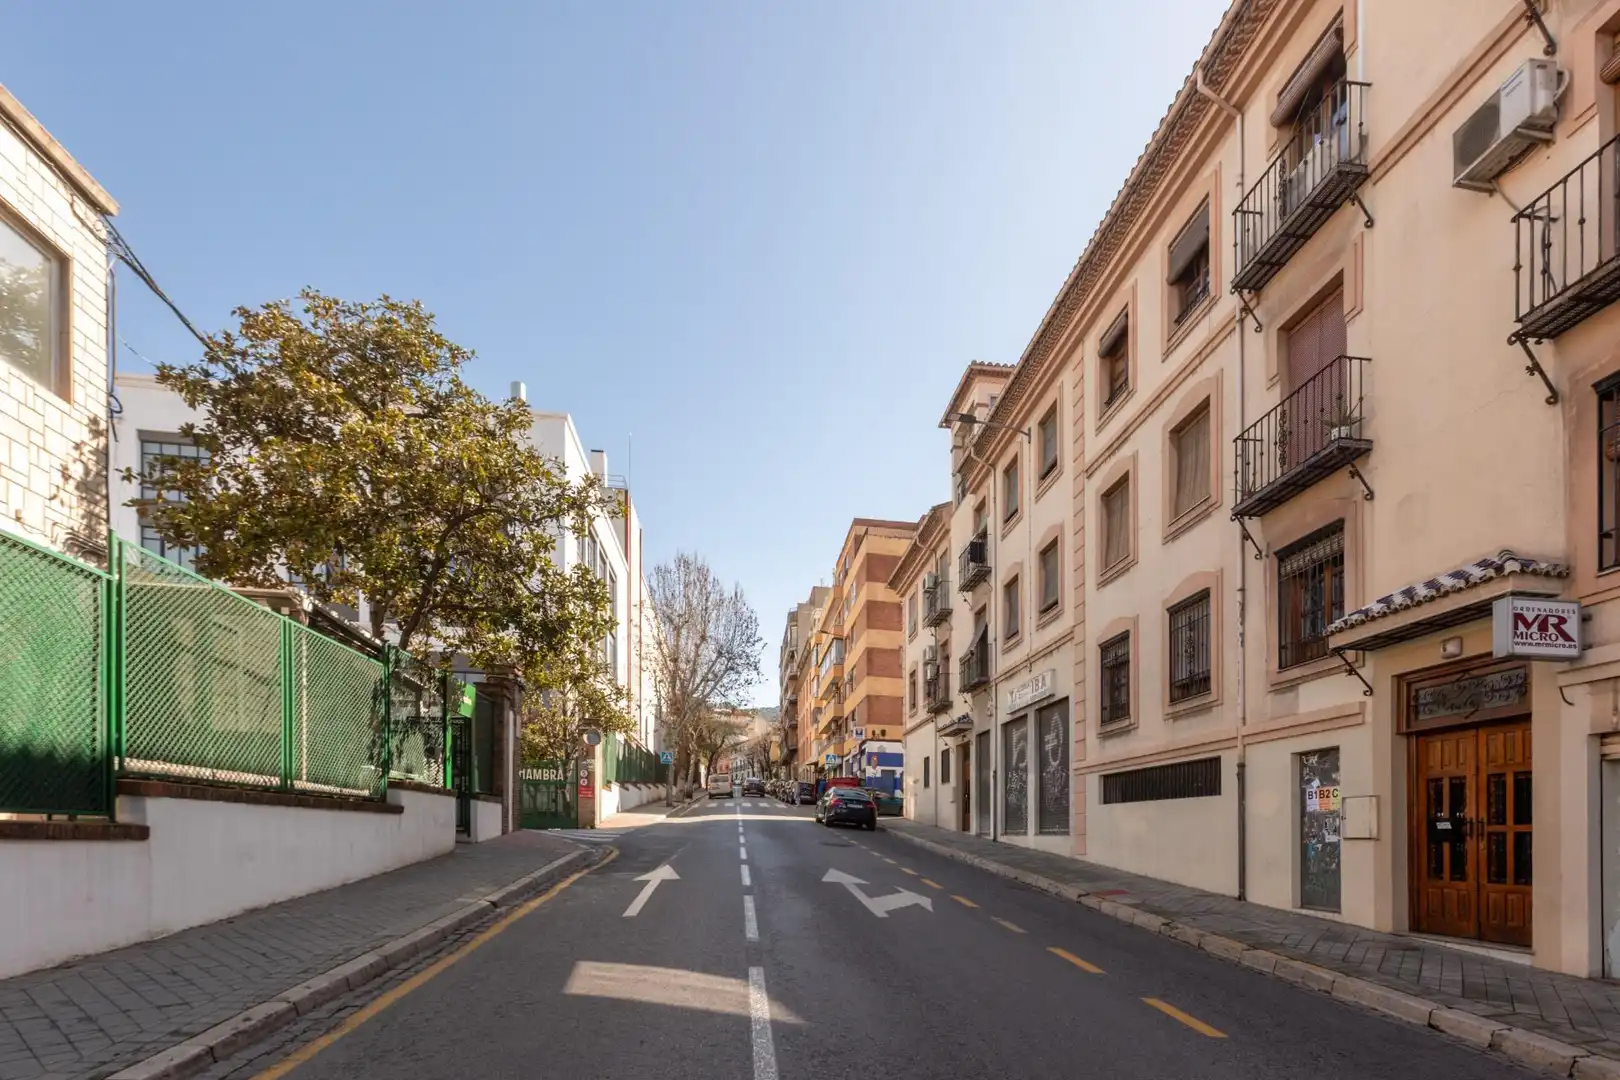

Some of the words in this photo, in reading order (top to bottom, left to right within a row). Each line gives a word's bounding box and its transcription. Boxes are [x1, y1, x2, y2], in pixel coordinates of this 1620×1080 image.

[1513, 606, 1576, 614] ORDENADORES
[1513, 612, 1576, 642] MR
[1513, 631, 1559, 642] MICRO
[1513, 640, 1577, 649] www.mrmicro.es
[1307, 790, 1318, 800] B1
[1319, 789, 1330, 799] B2
